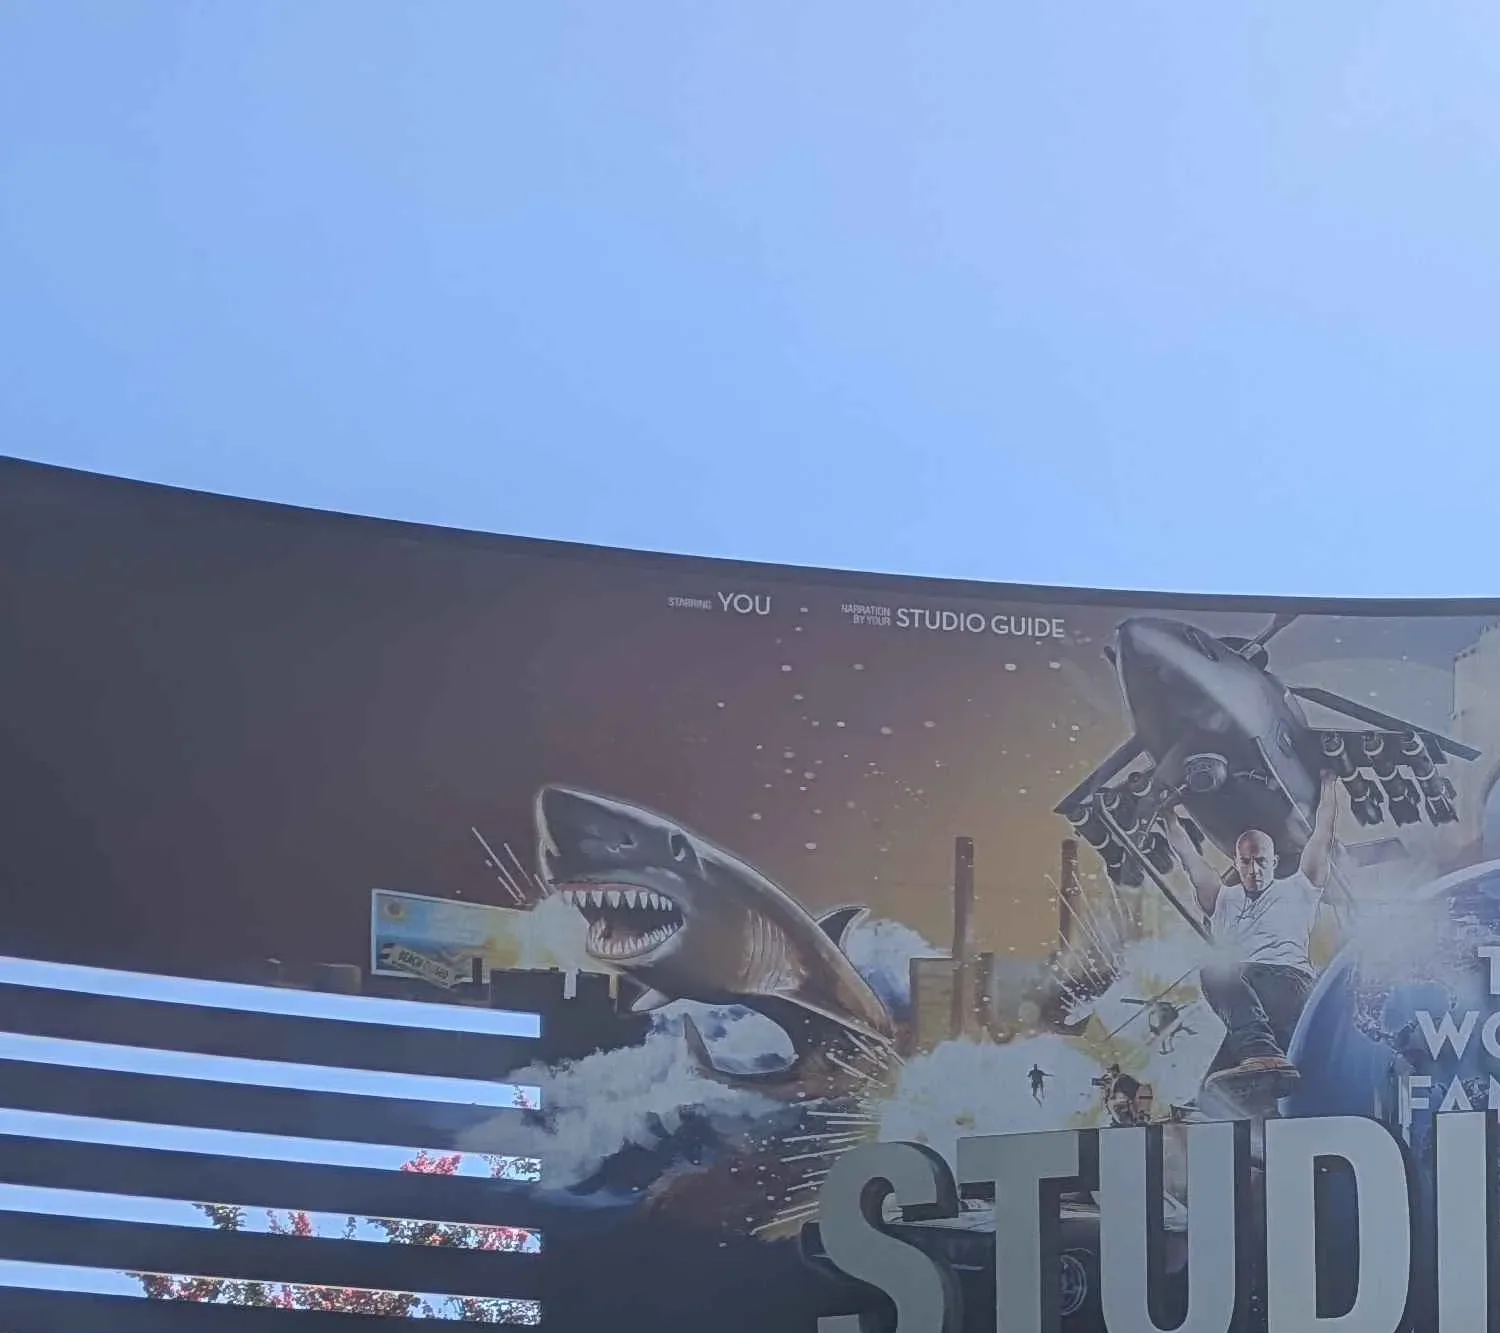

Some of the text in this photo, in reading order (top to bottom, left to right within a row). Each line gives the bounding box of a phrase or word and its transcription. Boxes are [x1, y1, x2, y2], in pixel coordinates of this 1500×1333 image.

[667, 591, 771, 616] STARRING YOU
[841, 603, 892, 618] NARRATION
[852, 614, 892, 627] BY YOUR
[895, 607, 1066, 639] STUDIO GUIDE
